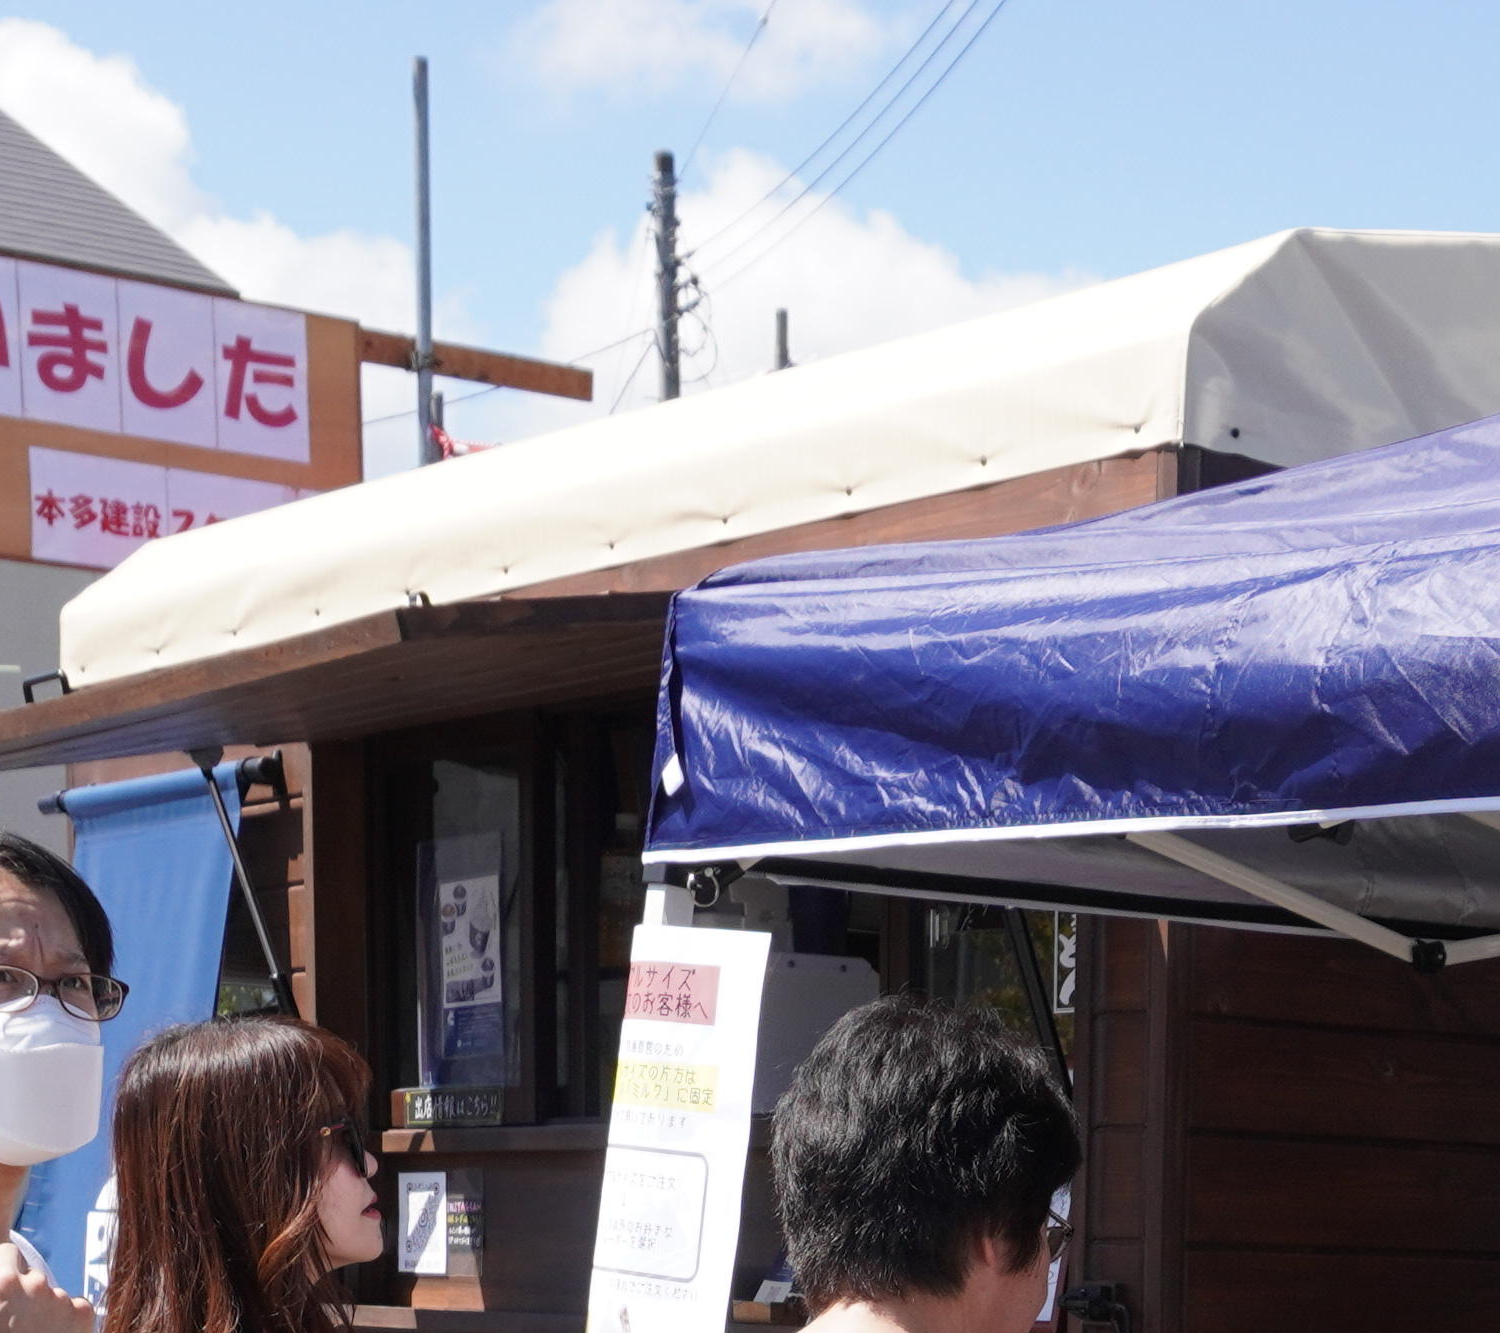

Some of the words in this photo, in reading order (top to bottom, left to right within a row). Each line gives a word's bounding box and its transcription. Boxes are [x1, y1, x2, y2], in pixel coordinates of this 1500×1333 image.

[34, 488, 227, 539] 本多建設ス
